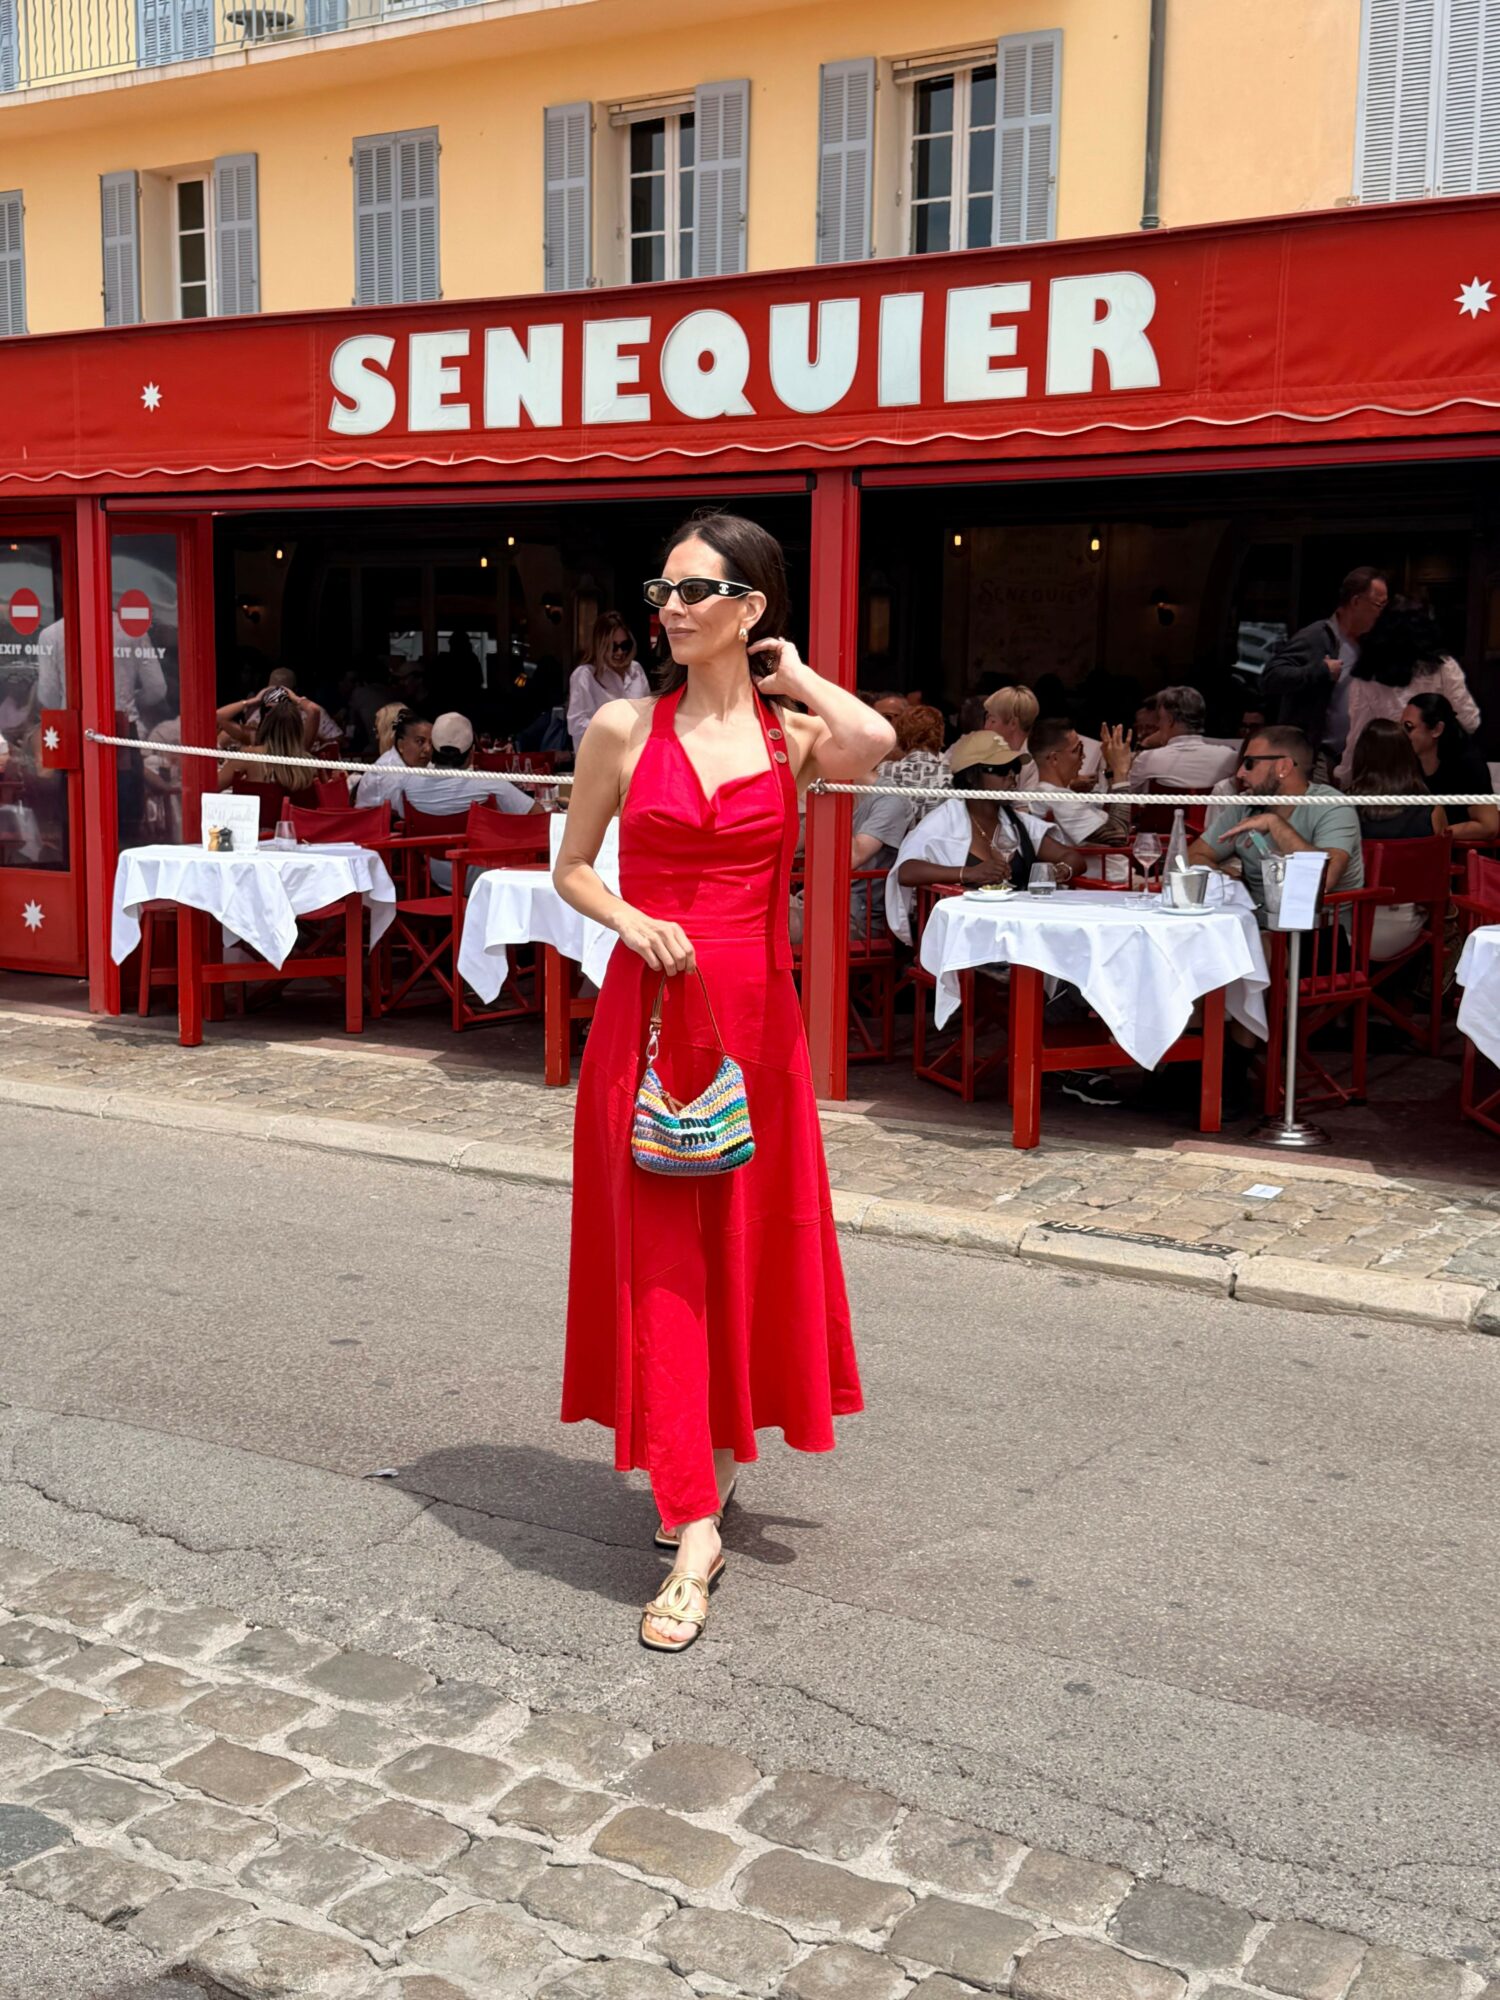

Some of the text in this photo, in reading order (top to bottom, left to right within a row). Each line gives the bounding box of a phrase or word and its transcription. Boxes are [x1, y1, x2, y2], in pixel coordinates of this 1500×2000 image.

[328, 270, 1161, 435] SENEQUIER
[0, 643, 54, 656] EXIT ONLY
[135, 647, 167, 659] ONLY
[680, 1118, 711, 1130] miu
[681, 1131, 717, 1147] miu
